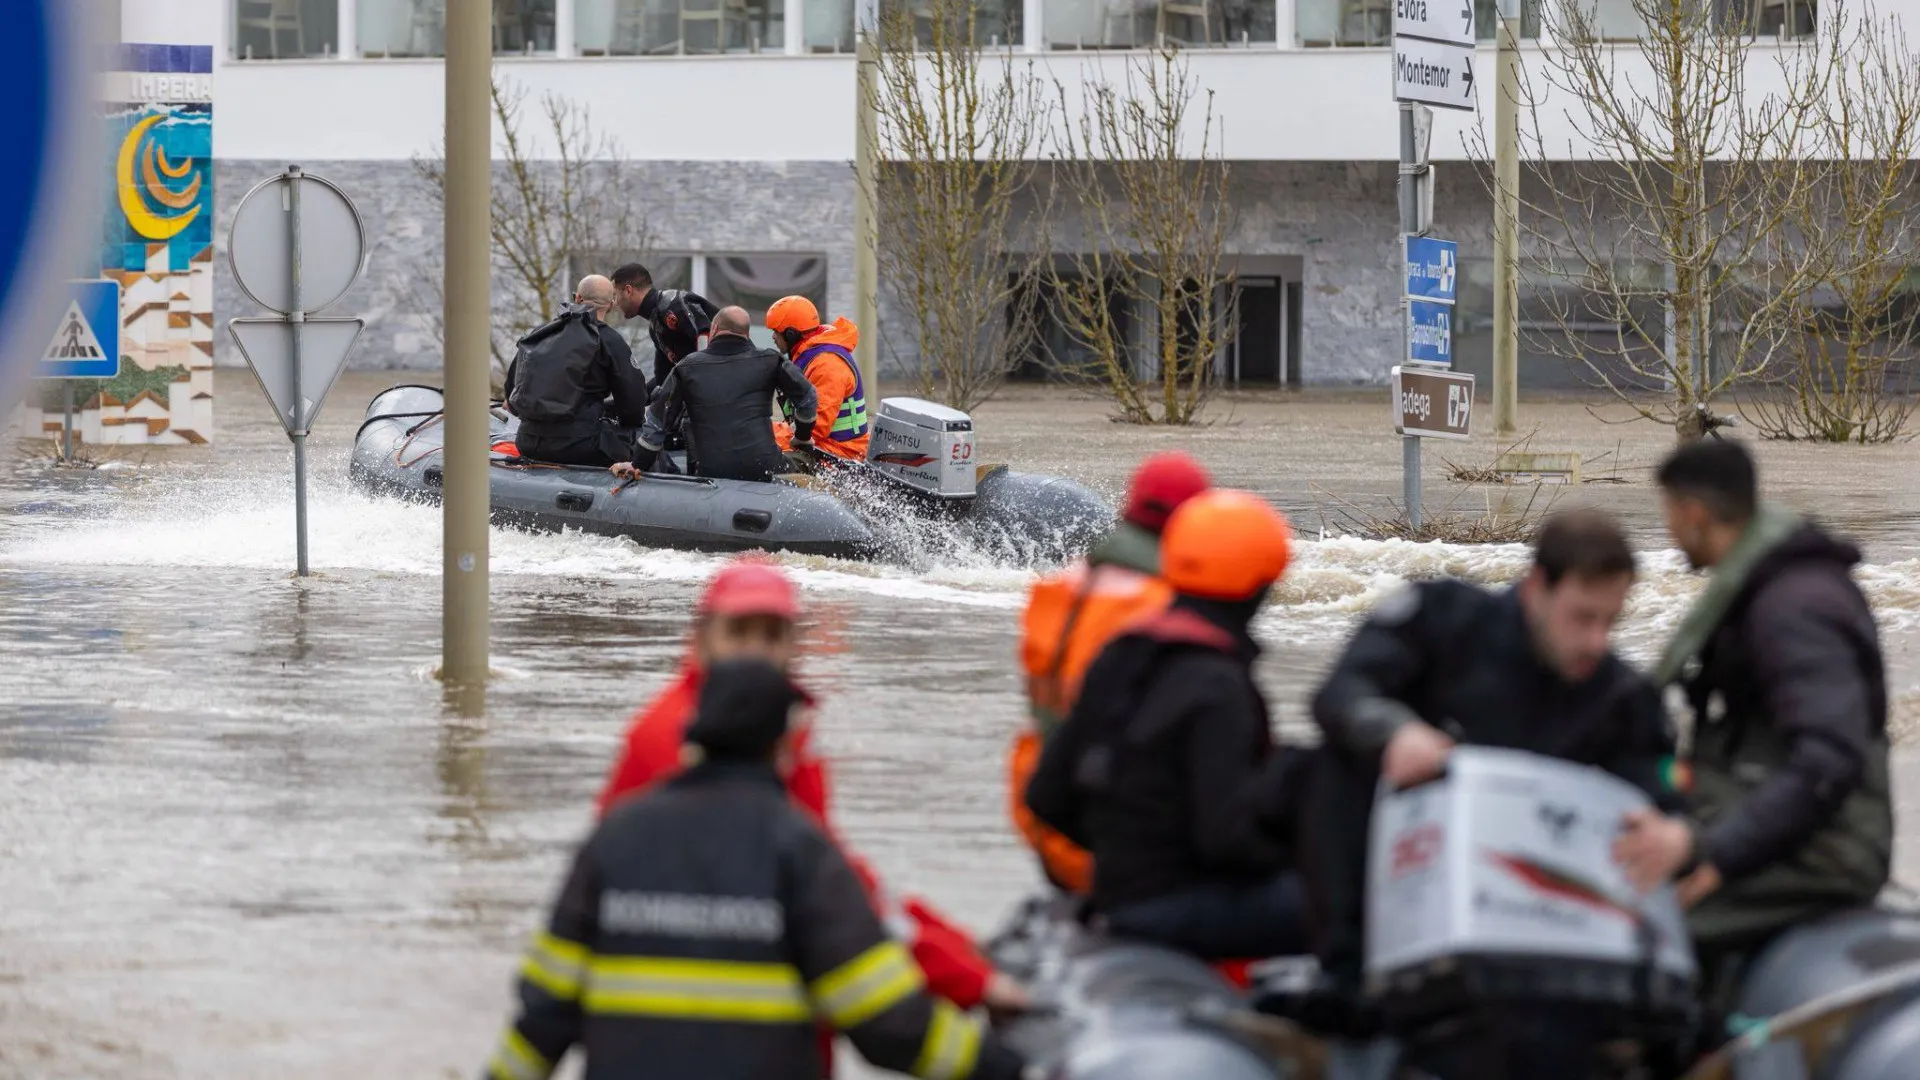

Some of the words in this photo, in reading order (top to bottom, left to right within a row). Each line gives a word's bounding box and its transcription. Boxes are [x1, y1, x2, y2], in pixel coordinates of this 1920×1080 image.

[1397, 53, 1450, 88] Montemor
[131, 77, 212, 100] IMPERA
[1402, 388, 1431, 422] adega
[884, 430, 920, 449] TOHATSU
[952, 443, 971, 459] 50
[900, 466, 939, 482] EverRun
